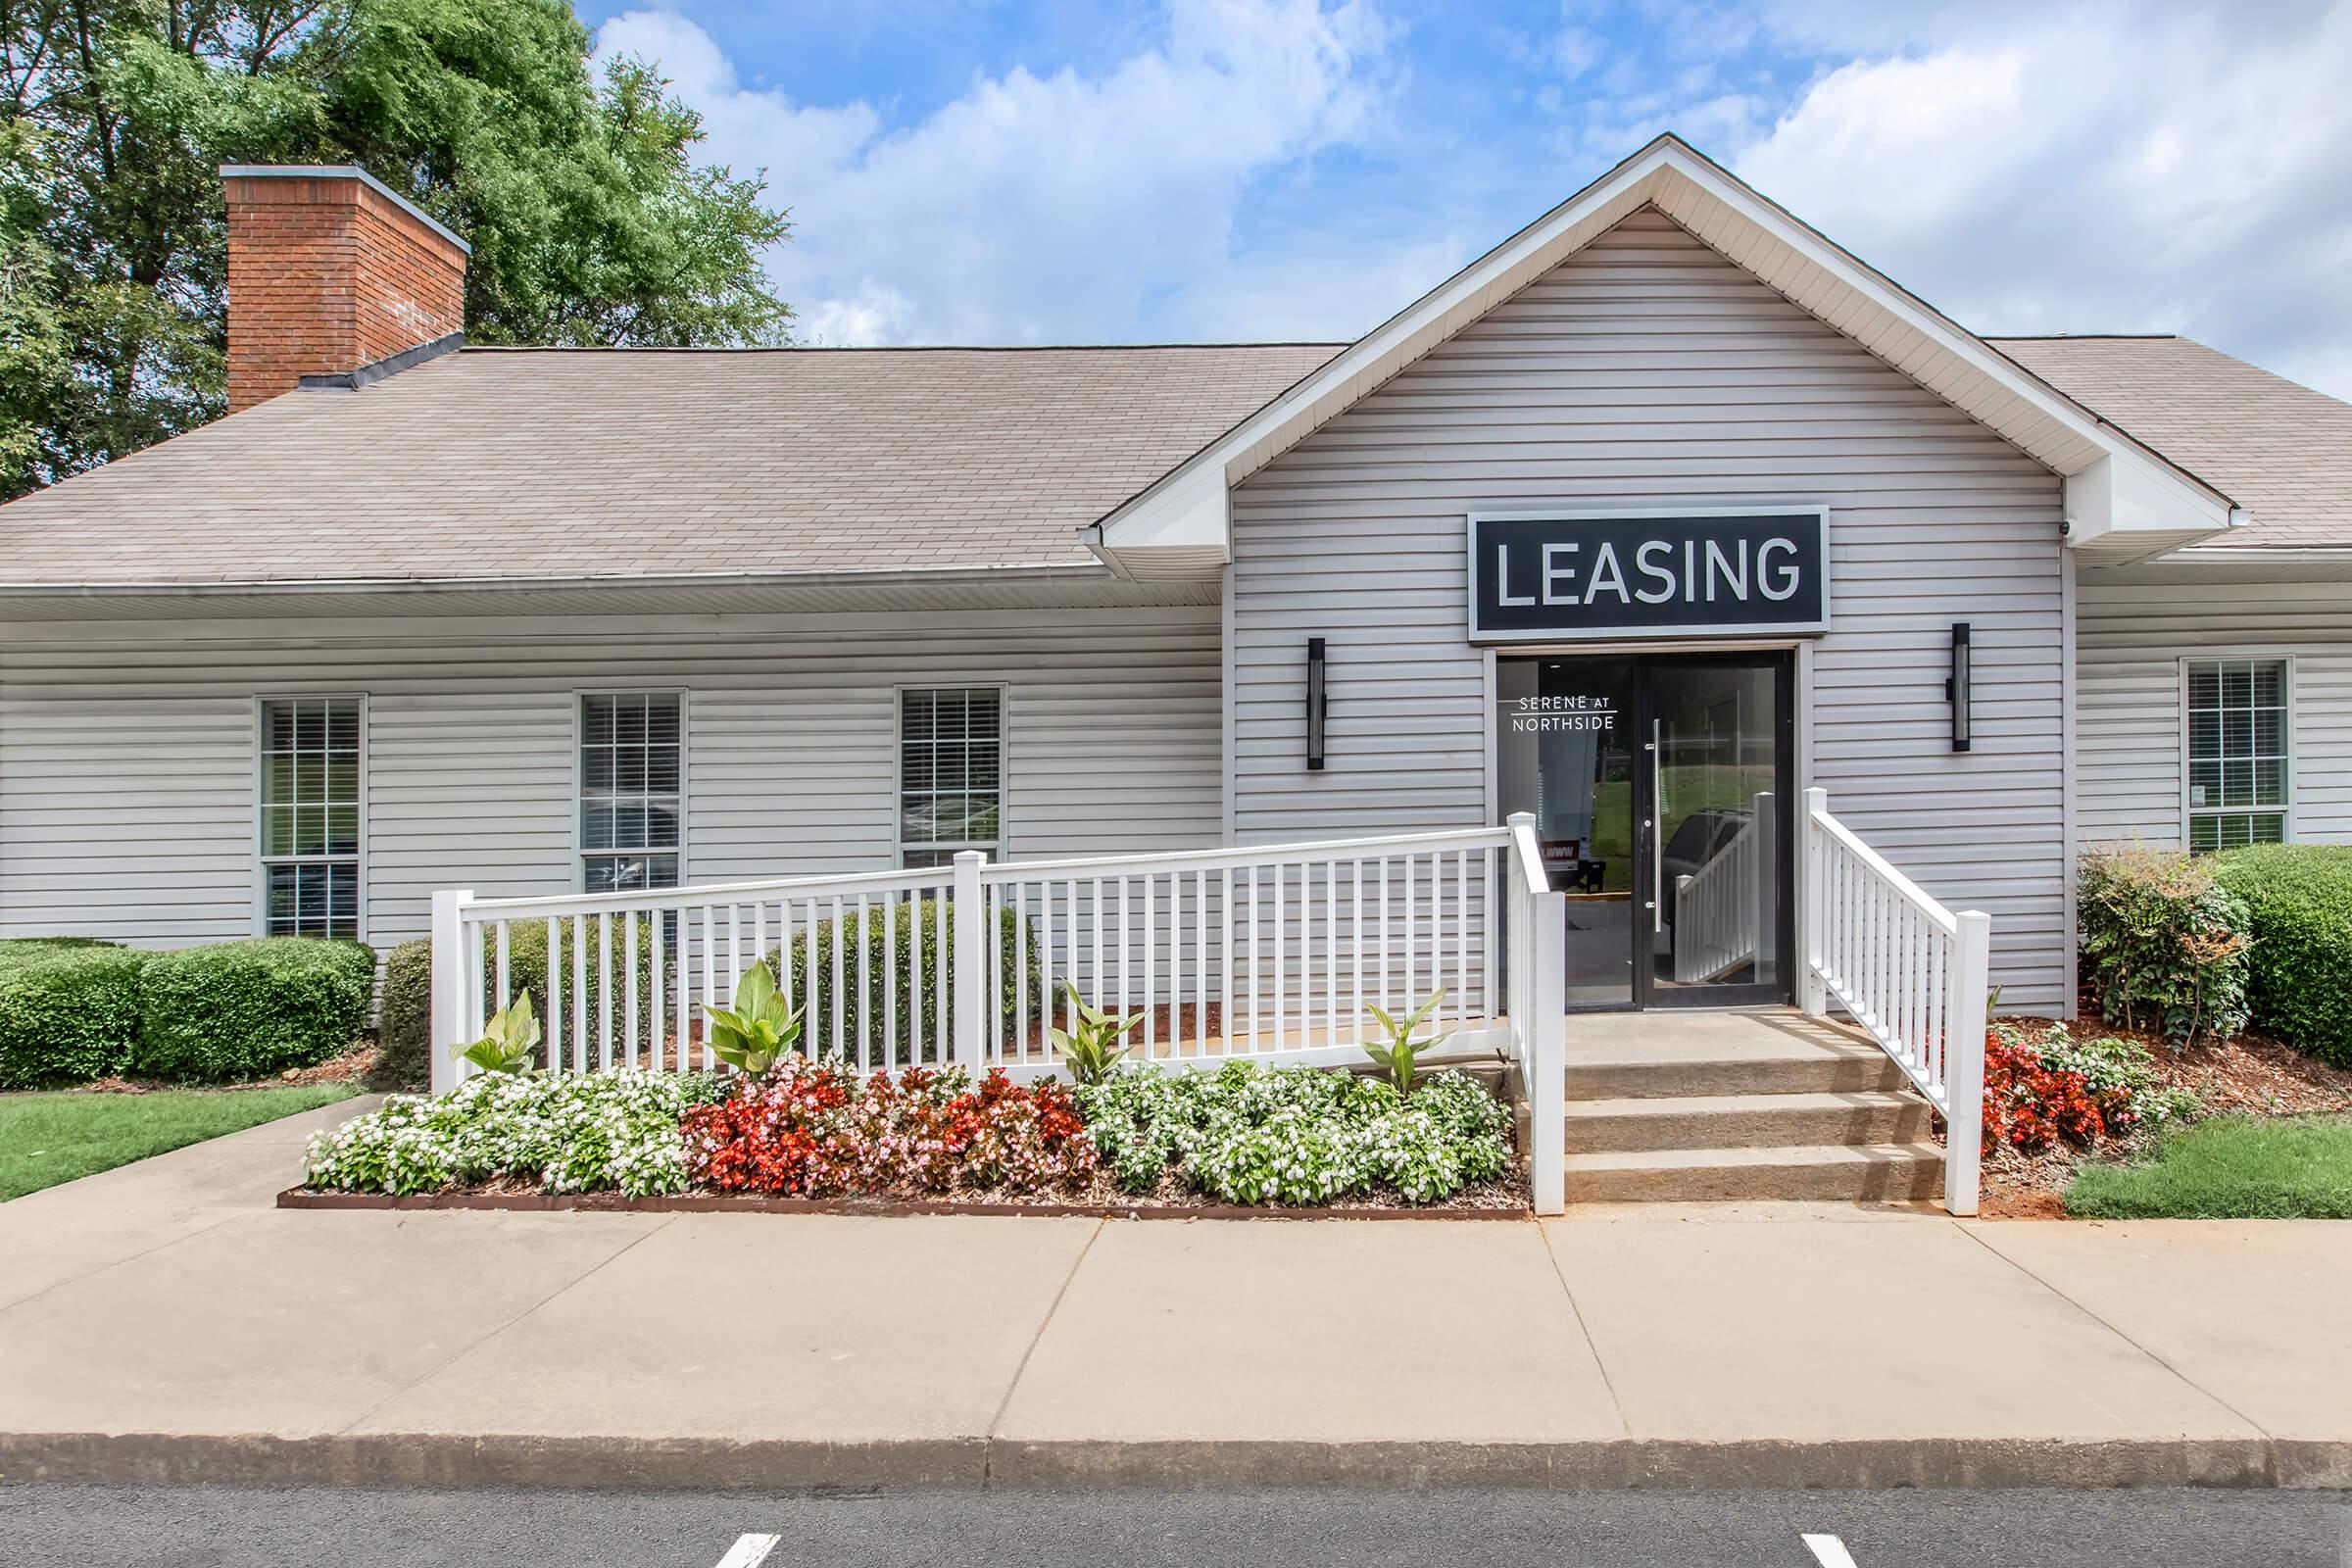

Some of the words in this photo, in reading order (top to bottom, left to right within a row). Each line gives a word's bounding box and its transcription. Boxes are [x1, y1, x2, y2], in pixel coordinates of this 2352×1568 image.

[1497, 538, 1800, 607] LEASING
[1519, 696, 1586, 710] SERENE
[1593, 697, 1609, 709] AT
[1512, 715, 1614, 732] NORTHSIDE
